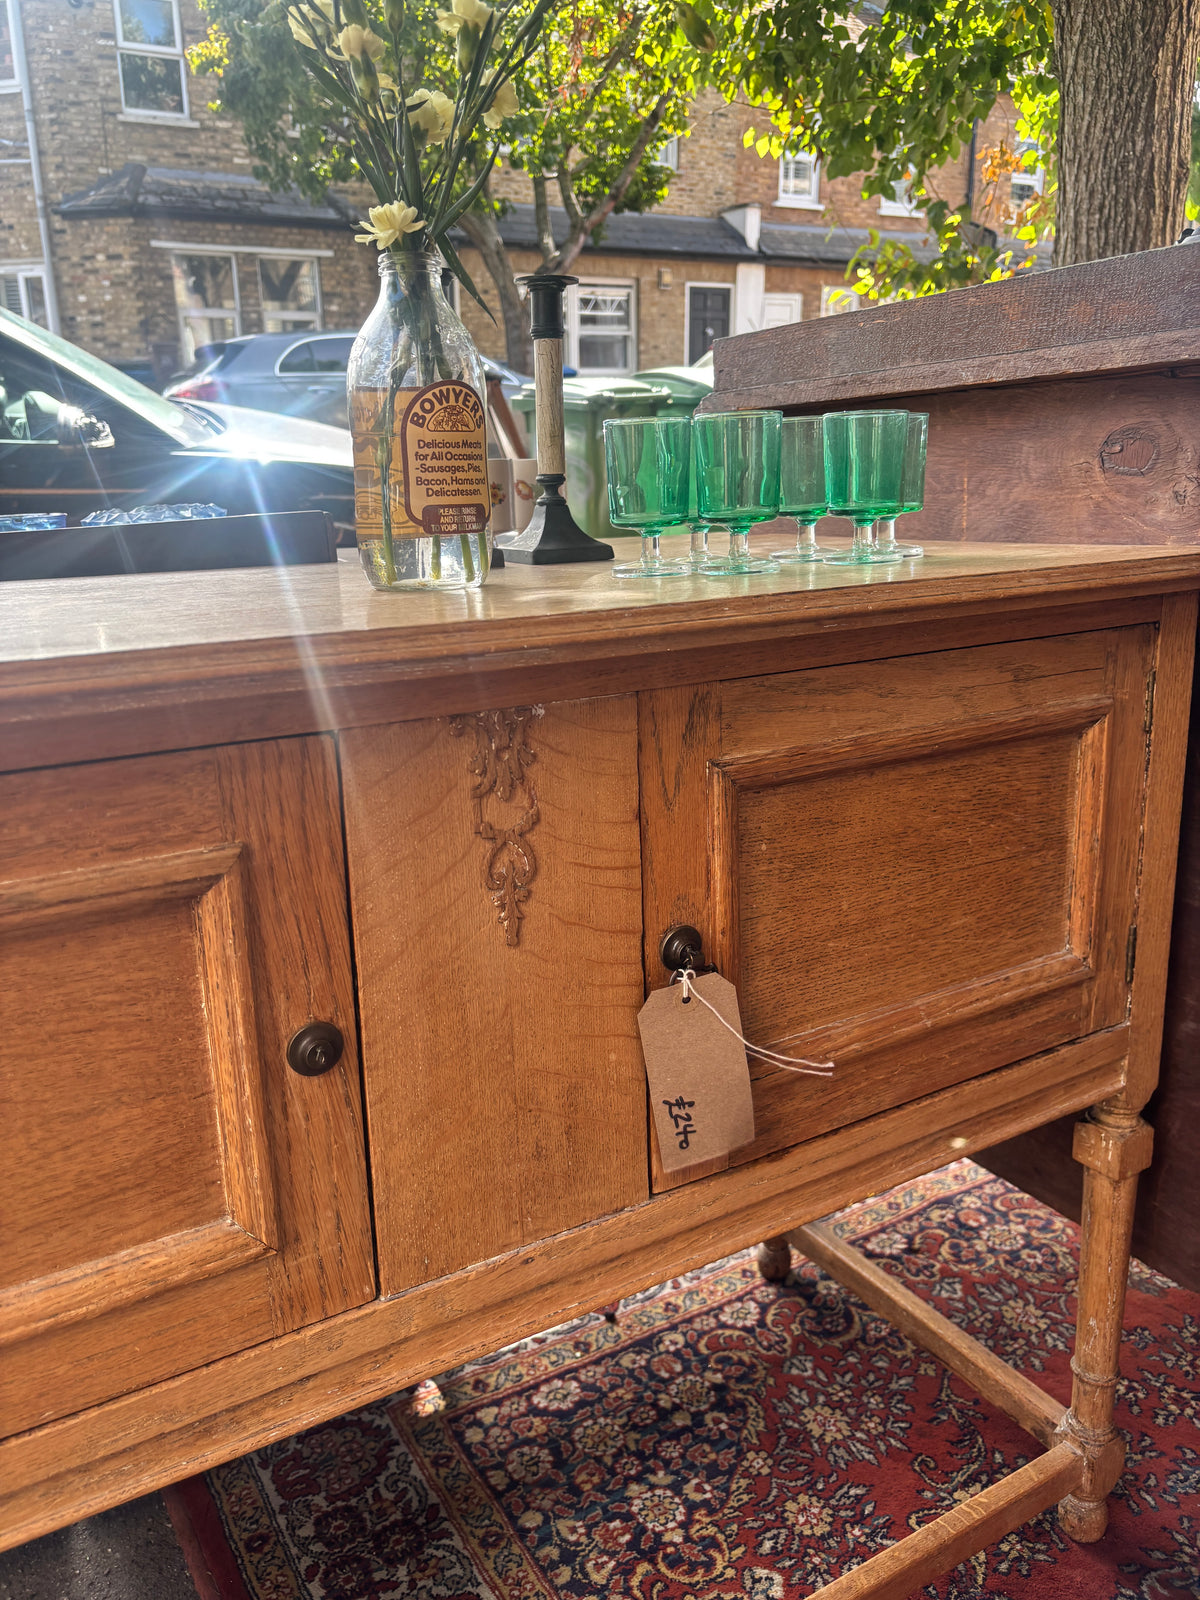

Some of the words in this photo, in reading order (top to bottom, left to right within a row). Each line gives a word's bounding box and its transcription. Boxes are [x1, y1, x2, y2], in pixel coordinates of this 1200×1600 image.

[409, 387, 484, 429] BOWYERS
[417, 439, 461, 449] Delicious
[461, 439, 482, 449] Meats
[414, 451, 429, 461] for
[430, 451, 444, 461] All
[444, 451, 483, 461] Occasions
[467, 463, 483, 473] Pies,
[415, 476, 450, 486] Bacon,
[450, 476, 475, 486] Hams
[474, 477, 486, 485] and
[425, 487, 482, 497] Delicatessen.
[438, 507, 461, 516] PLEASE
[440, 515, 454, 524] AND
[454, 515, 476, 523] RETURN
[430, 524, 440, 532] TO
[440, 523, 458, 532] YOUR
